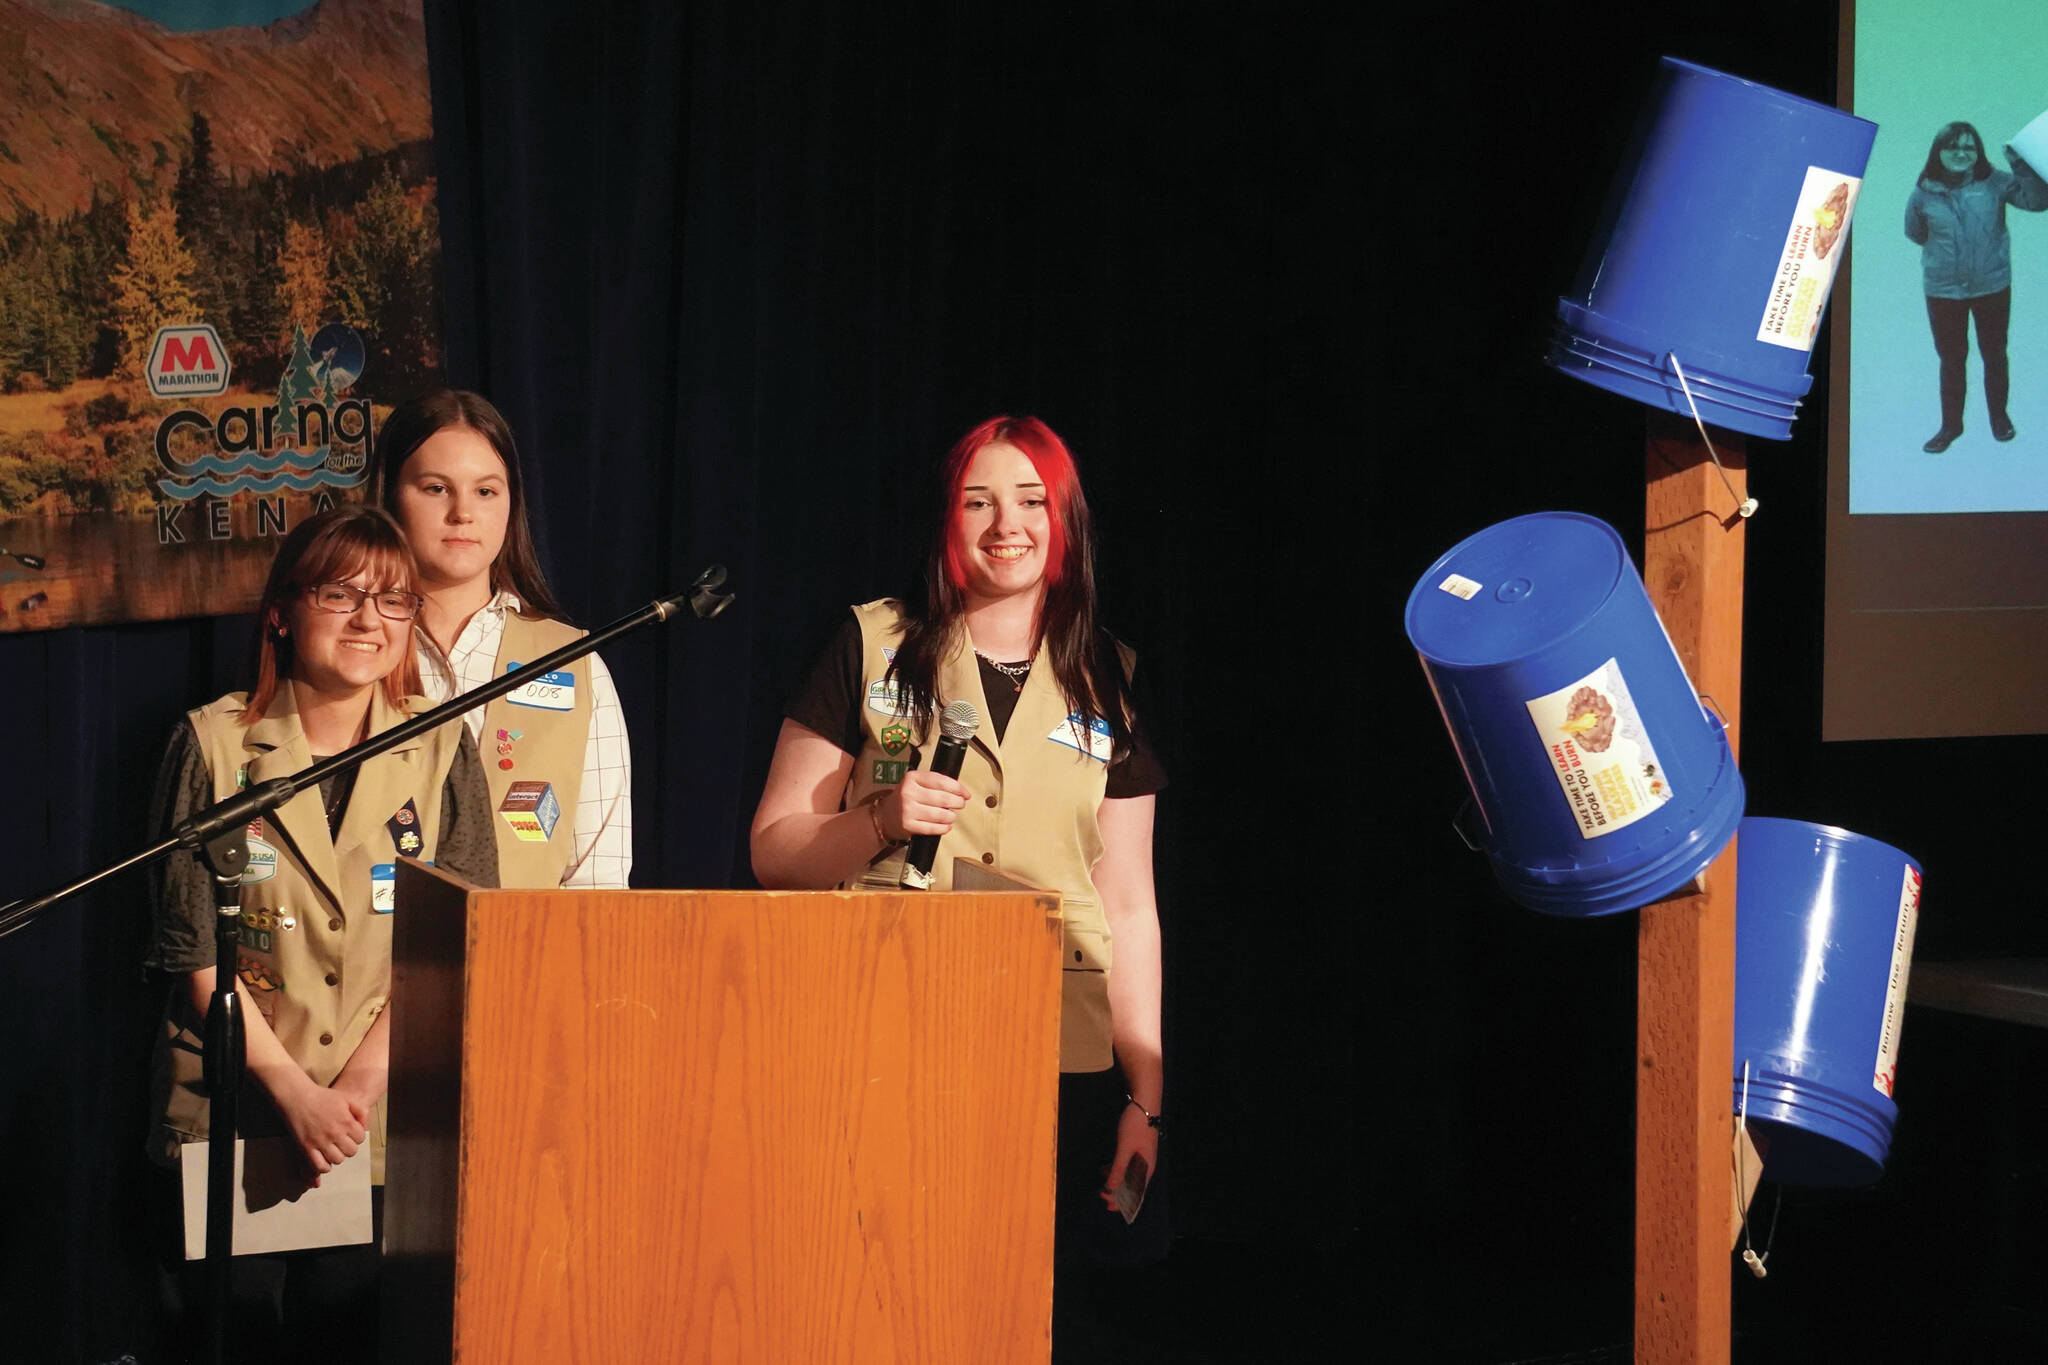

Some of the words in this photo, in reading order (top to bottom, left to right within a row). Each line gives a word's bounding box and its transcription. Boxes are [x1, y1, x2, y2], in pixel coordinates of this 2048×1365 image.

[1766, 307, 1777, 331] TAKE
[1774, 280, 1786, 302] TIME
[1788, 225, 1803, 259] LEARN
[1774, 293, 1792, 333] BEFORE
[1789, 263, 1800, 288] YOU
[1797, 227, 1812, 259] BURN
[161, 336, 215, 372] M
[159, 373, 219, 386] MARATHON
[157, 492, 336, 544] KENA
[1552, 744, 1569, 772] LEARN
[1562, 740, 1581, 767] BURN
[1565, 774, 1576, 786] TO
[1577, 769, 1591, 790] YOU
[1570, 788, 1584, 807] TIME
[1586, 792, 1607, 826] BEFORE
[1579, 808, 1594, 829] TAKE
[1882, 1002, 1894, 1054] Borrow
[1891, 964, 1900, 989] Use
[1897, 903, 1909, 951] Return
